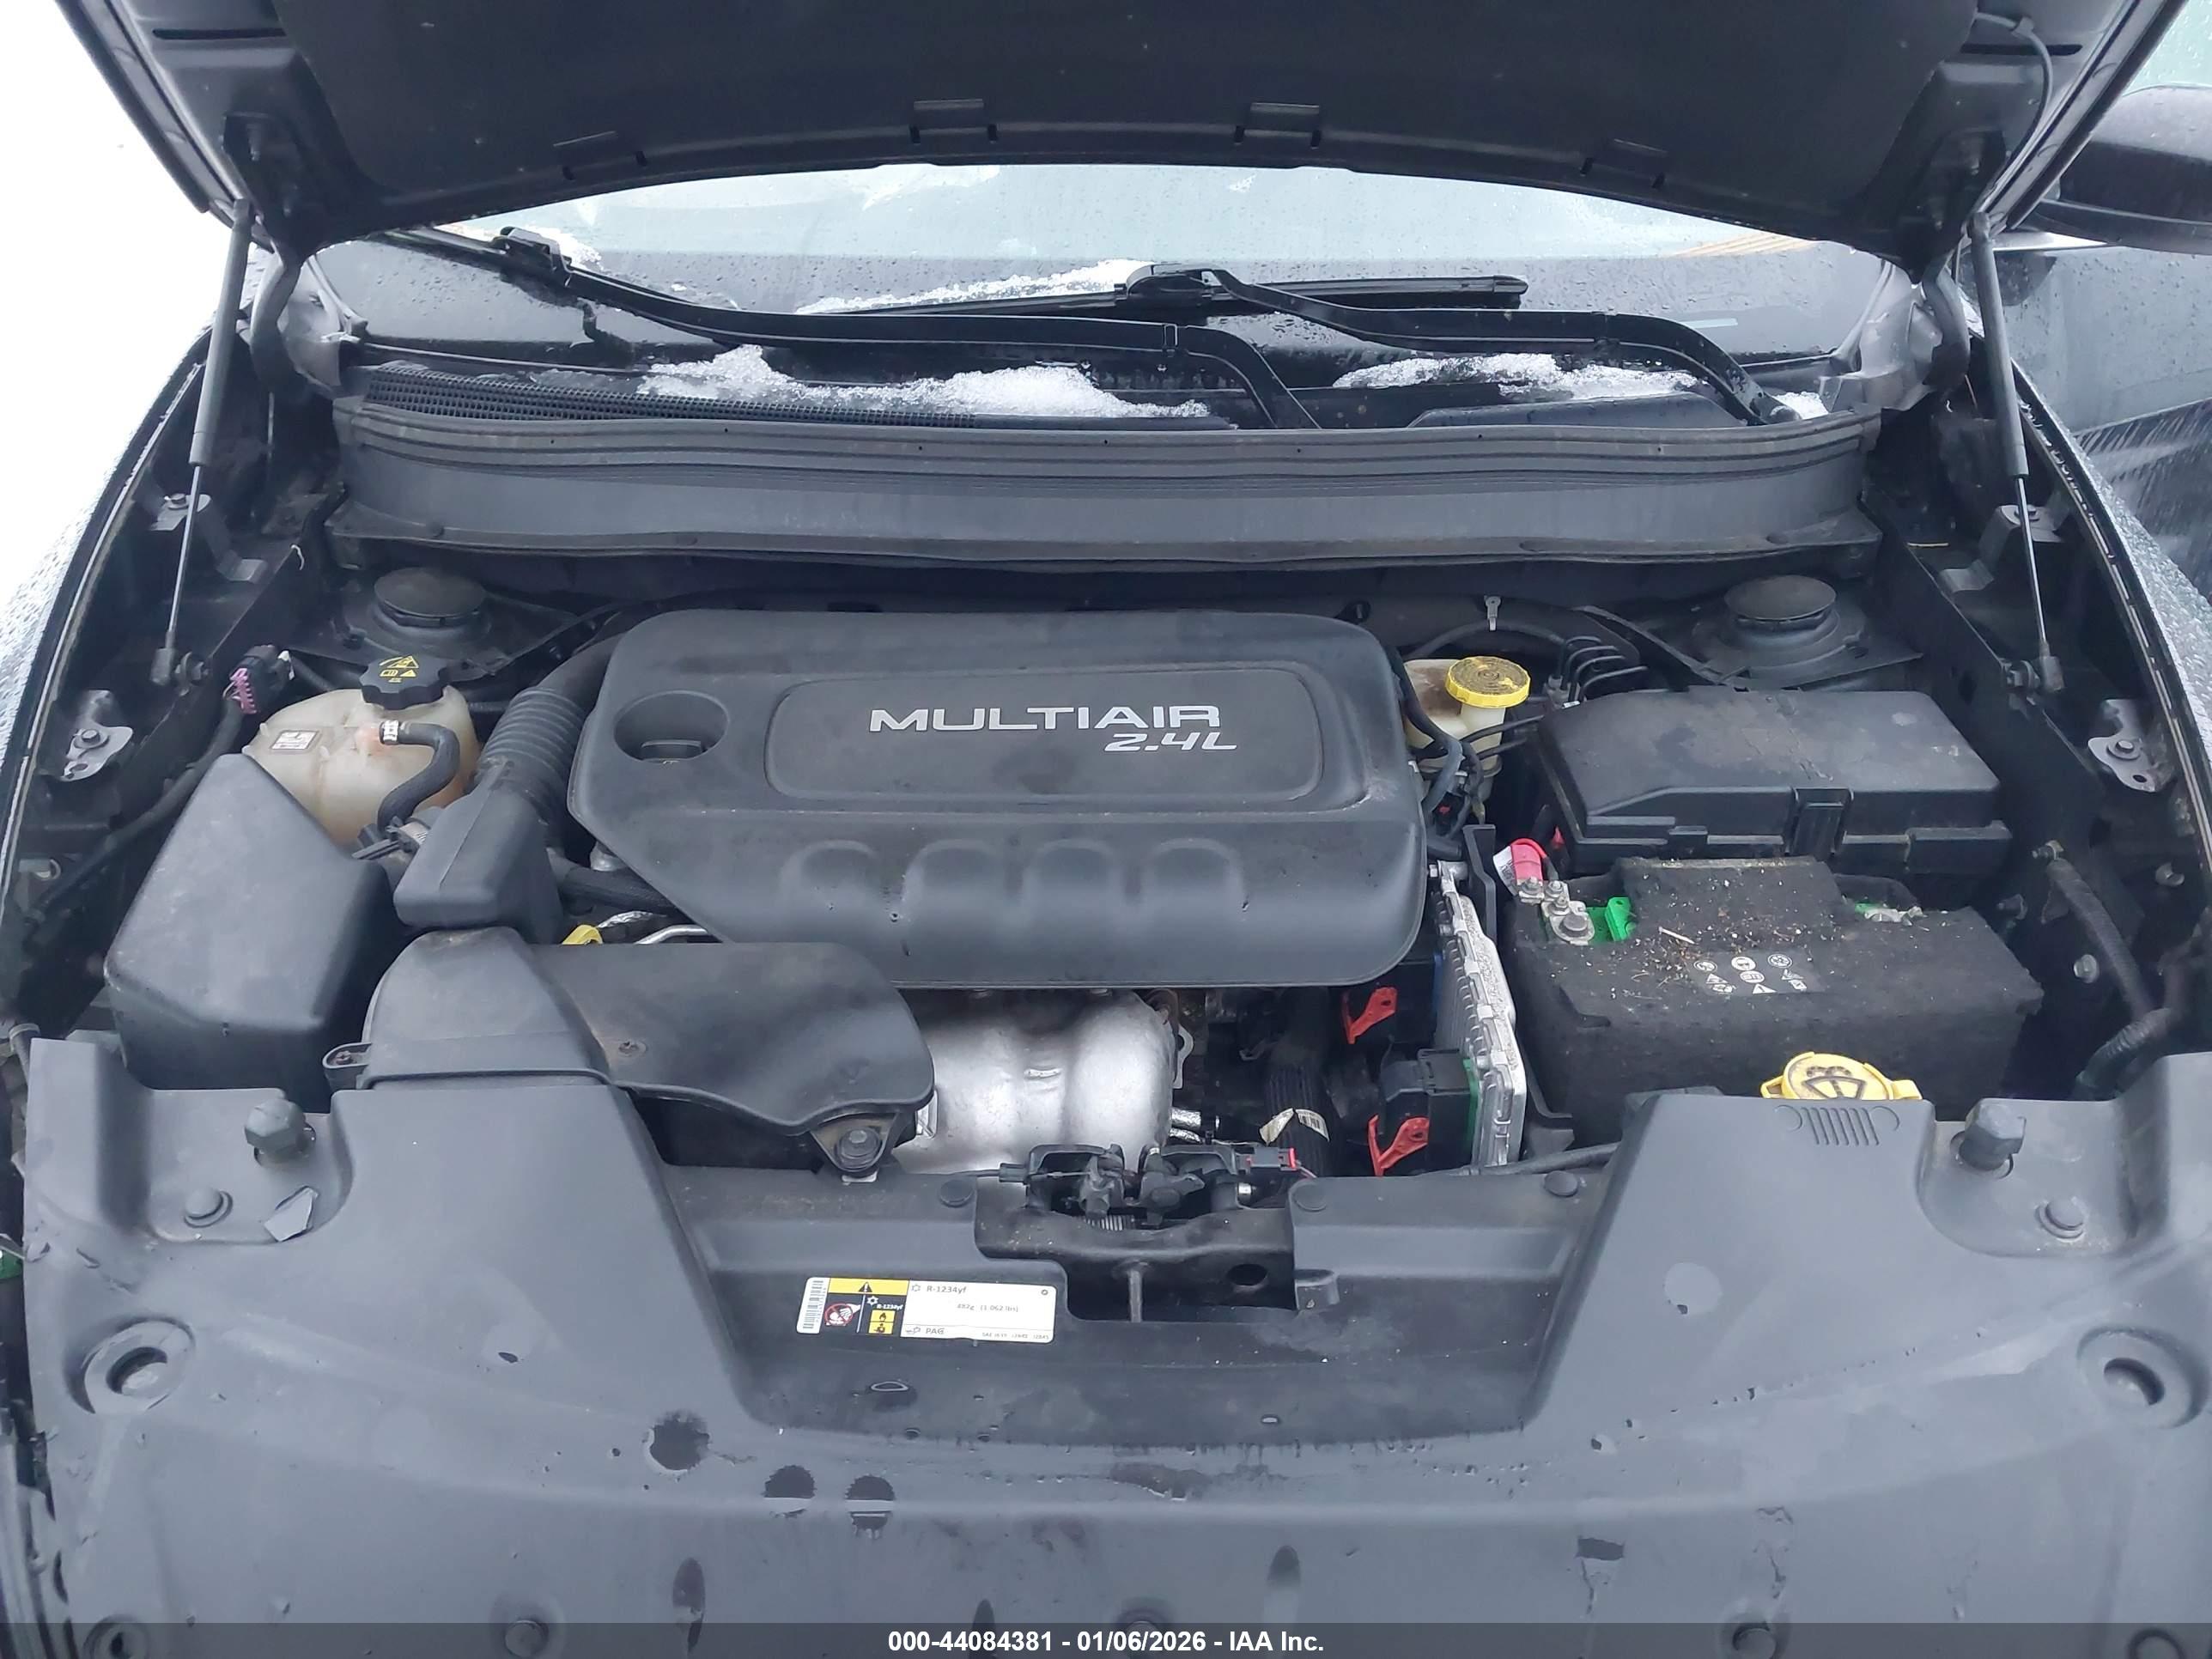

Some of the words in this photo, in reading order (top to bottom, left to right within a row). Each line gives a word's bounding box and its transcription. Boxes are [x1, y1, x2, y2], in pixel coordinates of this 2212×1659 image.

[868, 704, 1221, 732] MULTIAIR
[1104, 731, 1237, 751] 2.4L
[926, 1285, 967, 1295] R-1234yf
[925, 1327, 945, 1335] PAG
